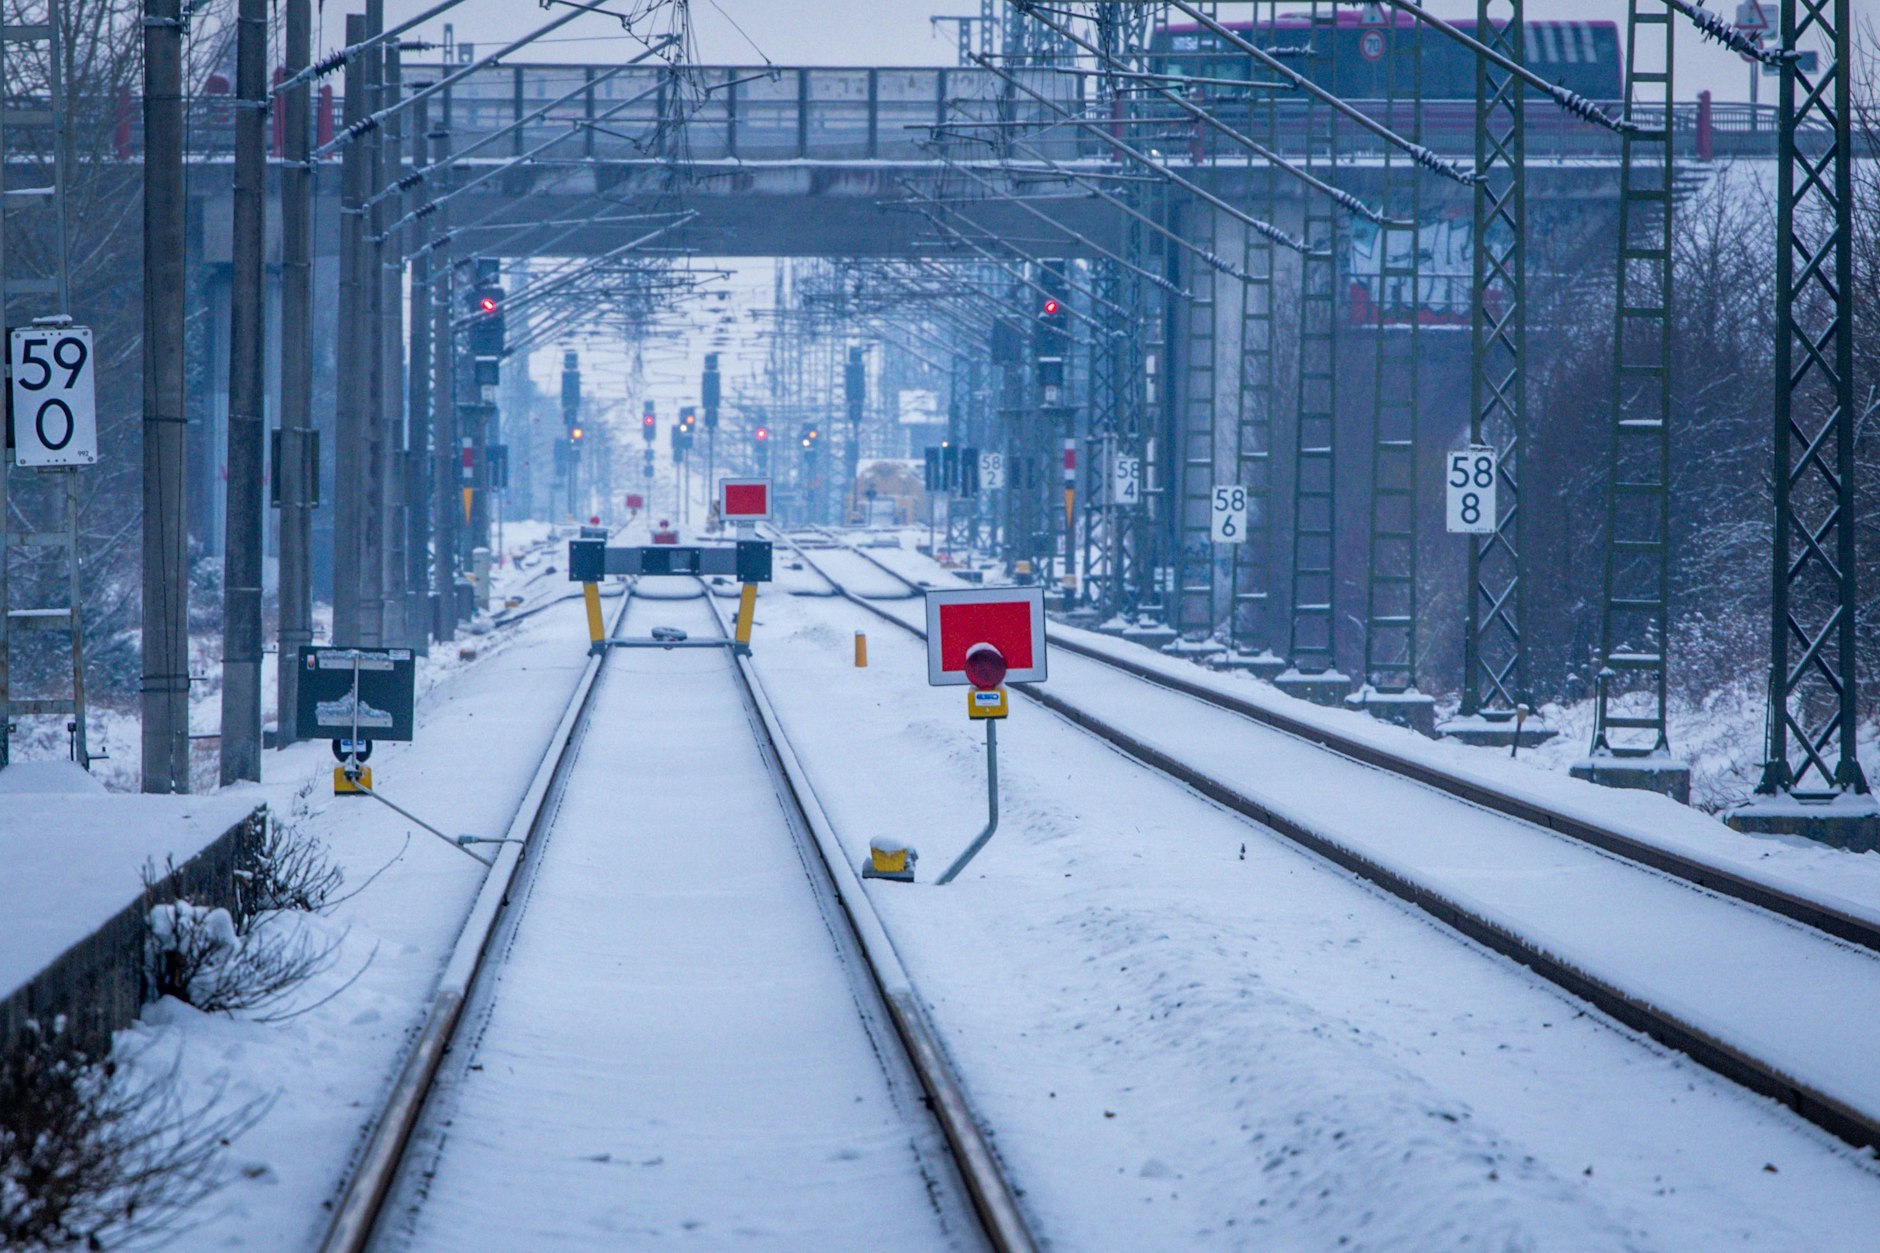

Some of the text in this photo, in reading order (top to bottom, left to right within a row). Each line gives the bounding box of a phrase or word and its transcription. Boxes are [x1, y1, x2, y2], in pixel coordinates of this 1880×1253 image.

[1366, 38, 1380, 53] 70
[18, 337, 88, 390] 59
[36, 398, 74, 451] 0
[982, 456, 1001, 470] 58
[1117, 461, 1139, 479] 58
[1449, 456, 1493, 488] 58
[988, 471, 996, 485] 2
[1123, 481, 1135, 498] 4
[1214, 489, 1245, 512] 58
[1461, 492, 1480, 524] 8
[1222, 515, 1236, 537] 6
